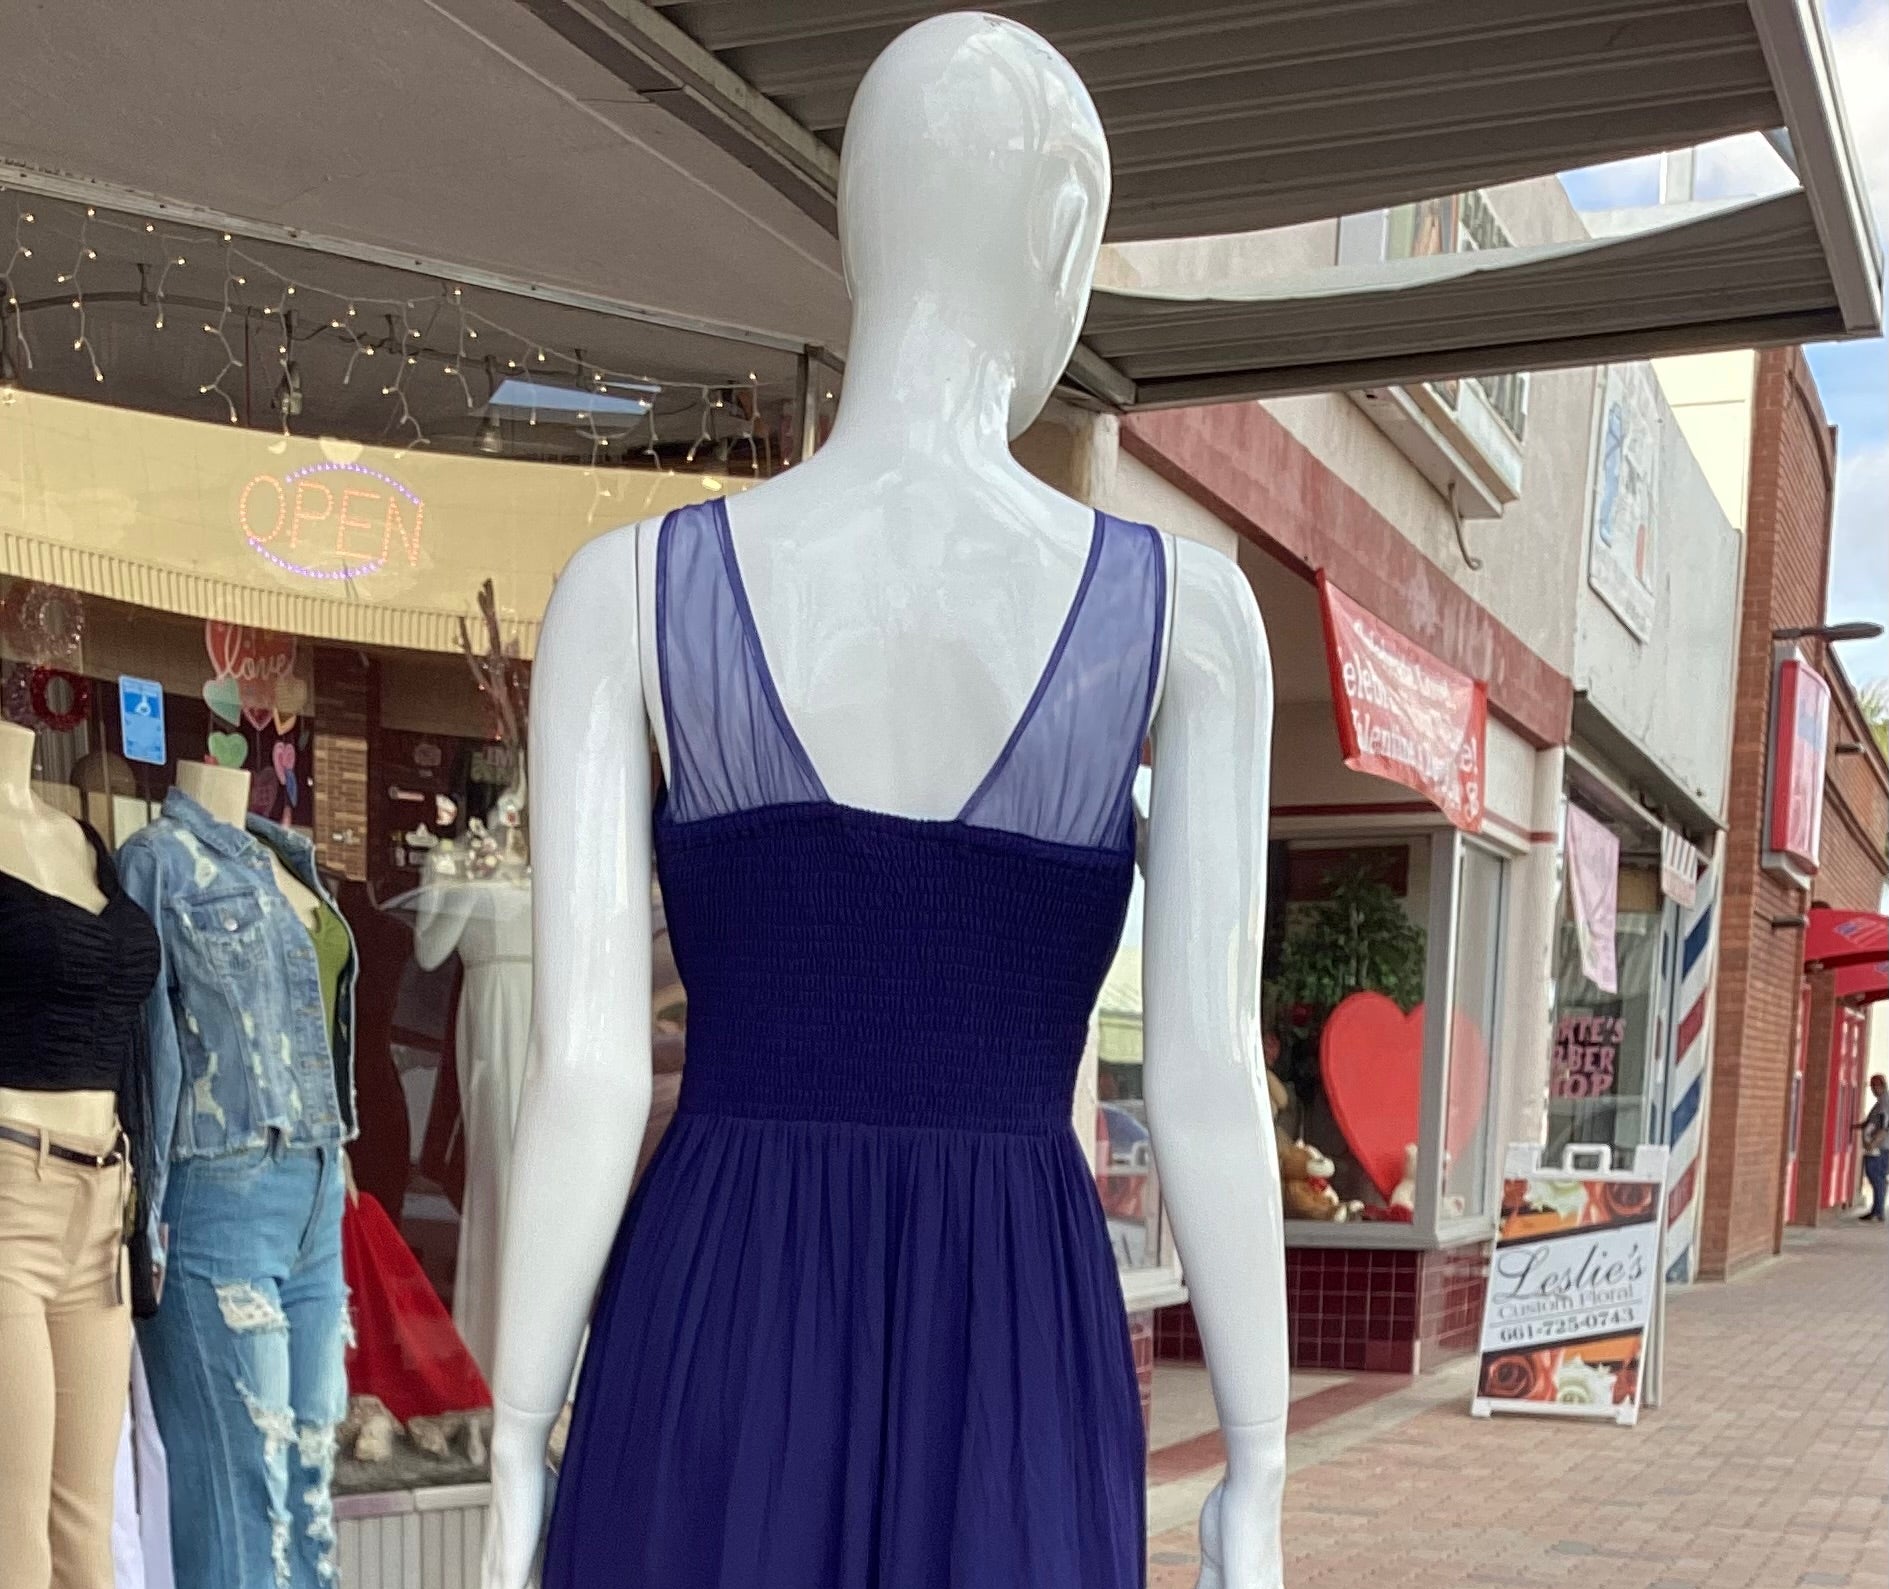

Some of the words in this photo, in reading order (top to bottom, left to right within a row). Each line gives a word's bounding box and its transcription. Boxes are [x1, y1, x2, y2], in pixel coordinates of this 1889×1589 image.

[240, 472, 424, 567] OPEN
[1493, 1243, 1643, 1304] Leslie's
[1499, 1292, 1575, 1320] Custom
[1579, 1284, 1634, 1307] Floral
[1500, 1306, 1635, 1342] 661-725-0743
